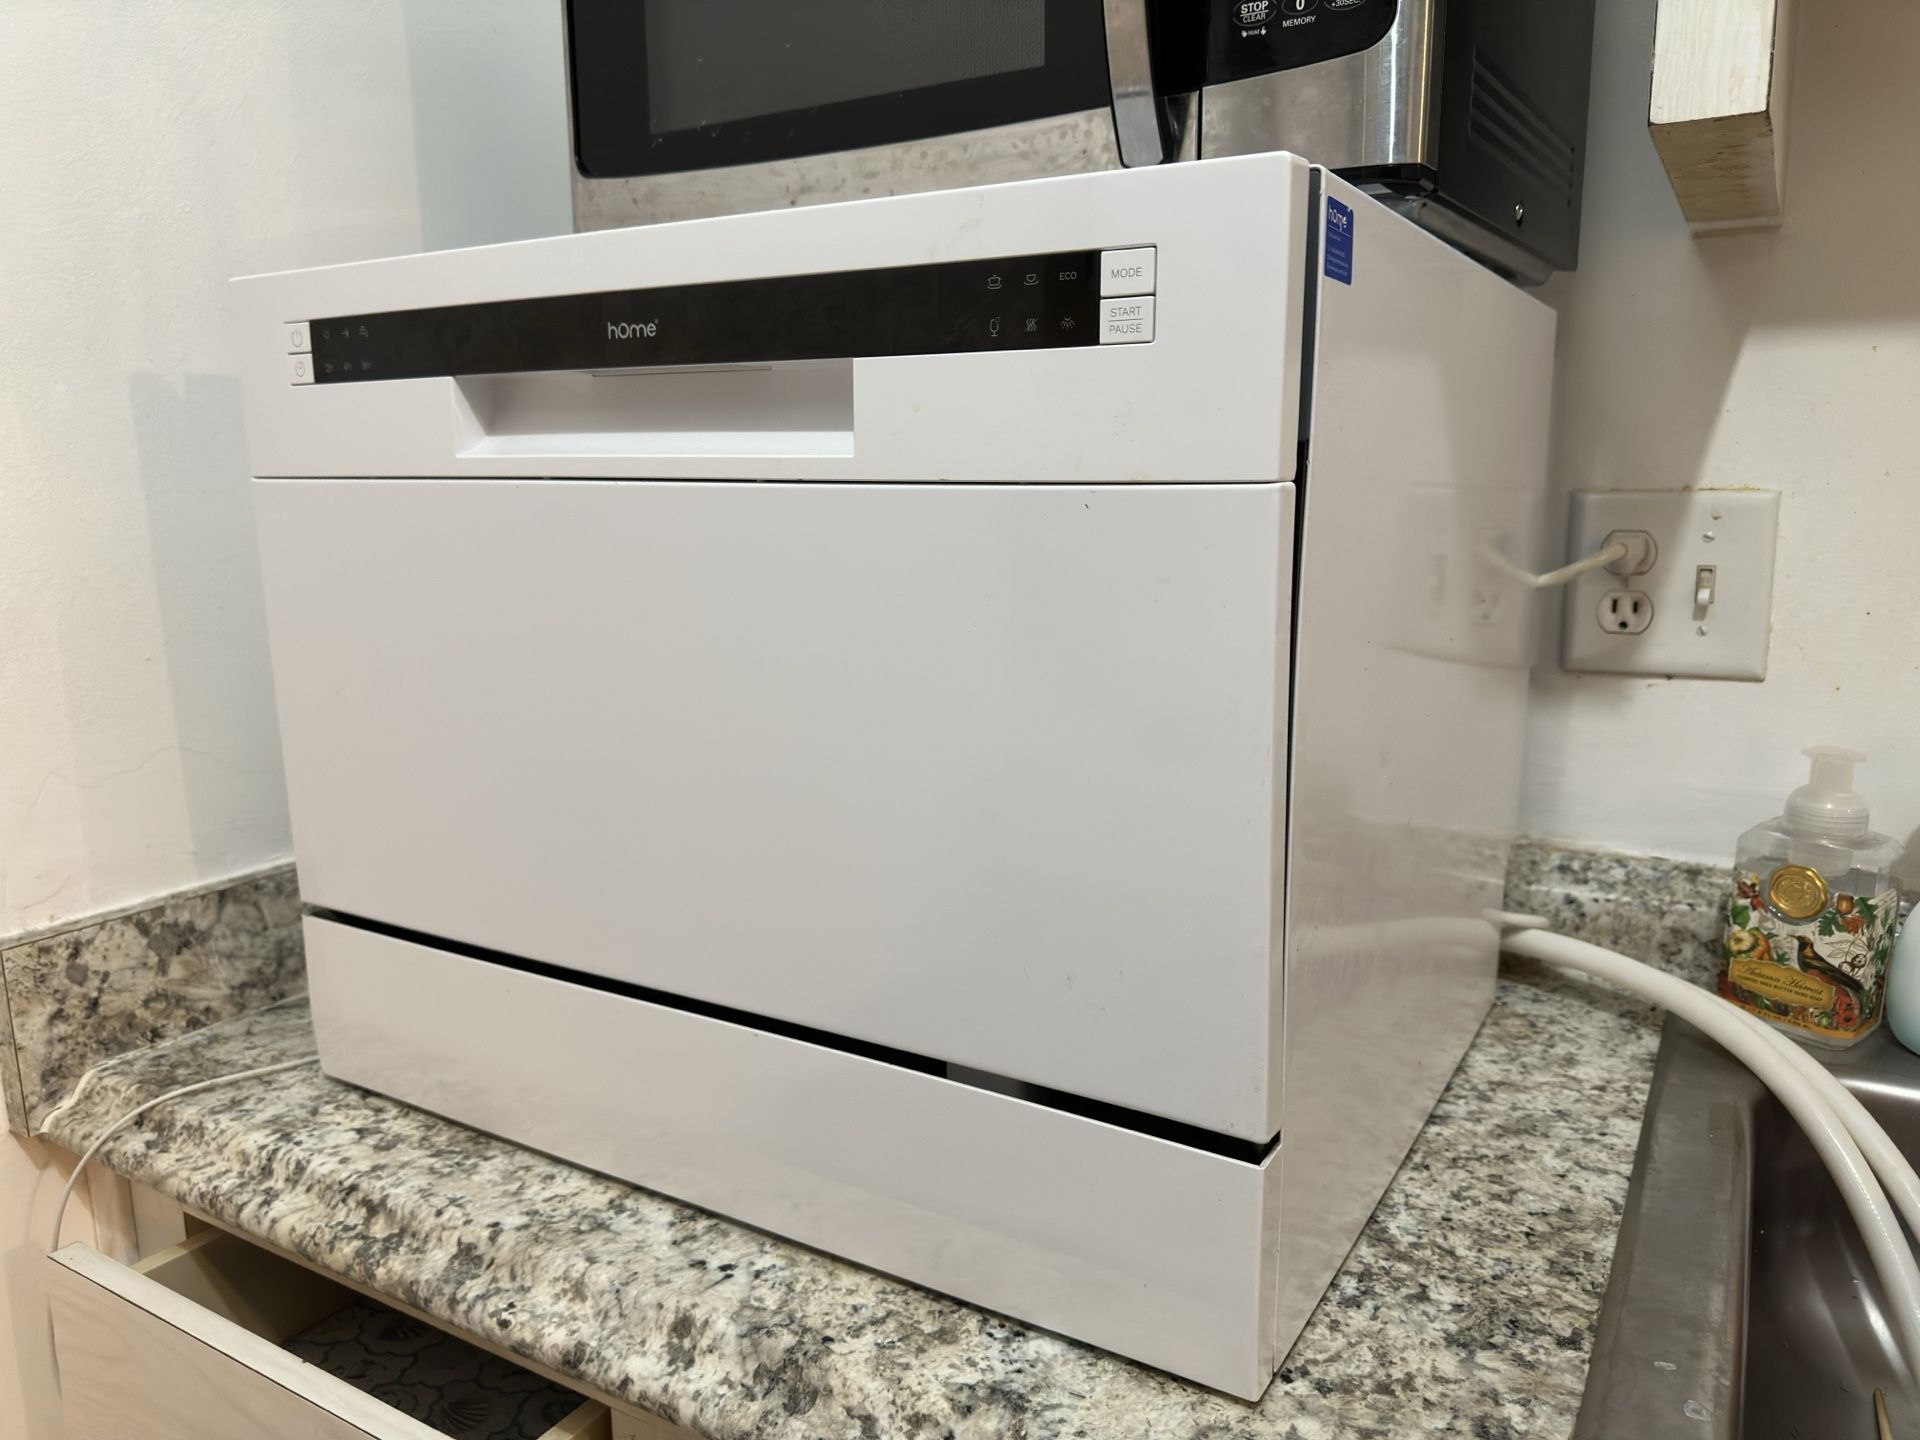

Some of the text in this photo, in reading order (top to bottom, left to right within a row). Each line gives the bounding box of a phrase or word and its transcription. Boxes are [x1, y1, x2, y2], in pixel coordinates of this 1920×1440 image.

[1241, 0, 1269, 14] STOP
[1243, 13, 1266, 23] CLEAR
[1282, 15, 1317, 28] MEMORY
[1059, 271, 1077, 281] ECO
[1111, 266, 1143, 279] MODE
[1110, 306, 1142, 317] START
[1109, 323, 1142, 334] PAUSE
